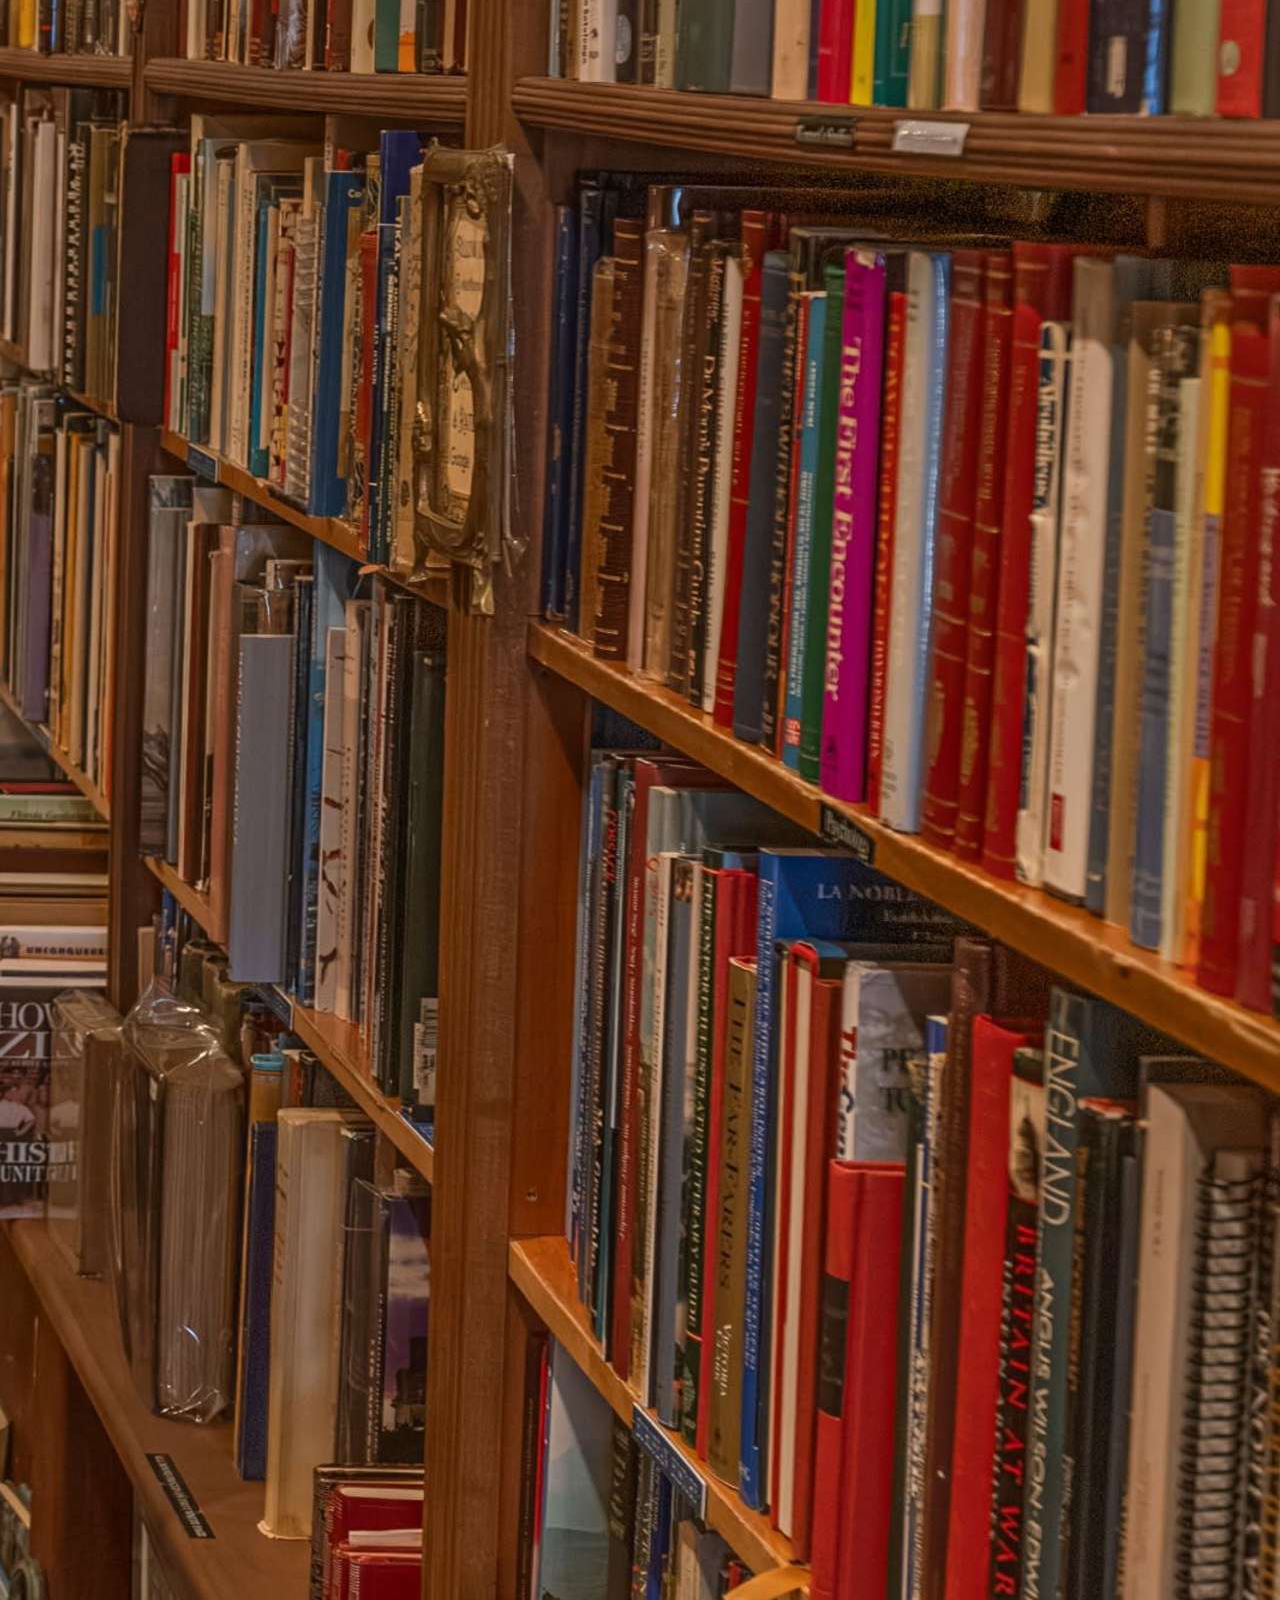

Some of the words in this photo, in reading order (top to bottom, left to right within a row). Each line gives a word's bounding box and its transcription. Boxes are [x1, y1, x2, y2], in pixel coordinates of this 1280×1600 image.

[840, 336, 862, 408] The
[834, 414, 858, 501] First
[825, 509, 854, 702] Encounter
[817, 883, 841, 899] LA
[697, 925, 711, 1010] OXFORD
[730, 996, 747, 1067] THE
[694, 1016, 709, 1153] ILLUSTRATED
[1042, 1028, 1081, 1226] ENGLAND
[686, 1158, 703, 1258] LITERARY
[720, 1082, 743, 1290] FAR-FARERS
[718, 1323, 733, 1397] VICTORIA
[1006, 1225, 1037, 1411] BRITAIN
[1036, 1267, 1055, 1379] ANGUS
[1003, 1430, 1026, 1486] AT
[1024, 1388, 1051, 1511] WILSON
[994, 1503, 1022, 1595] WAR
